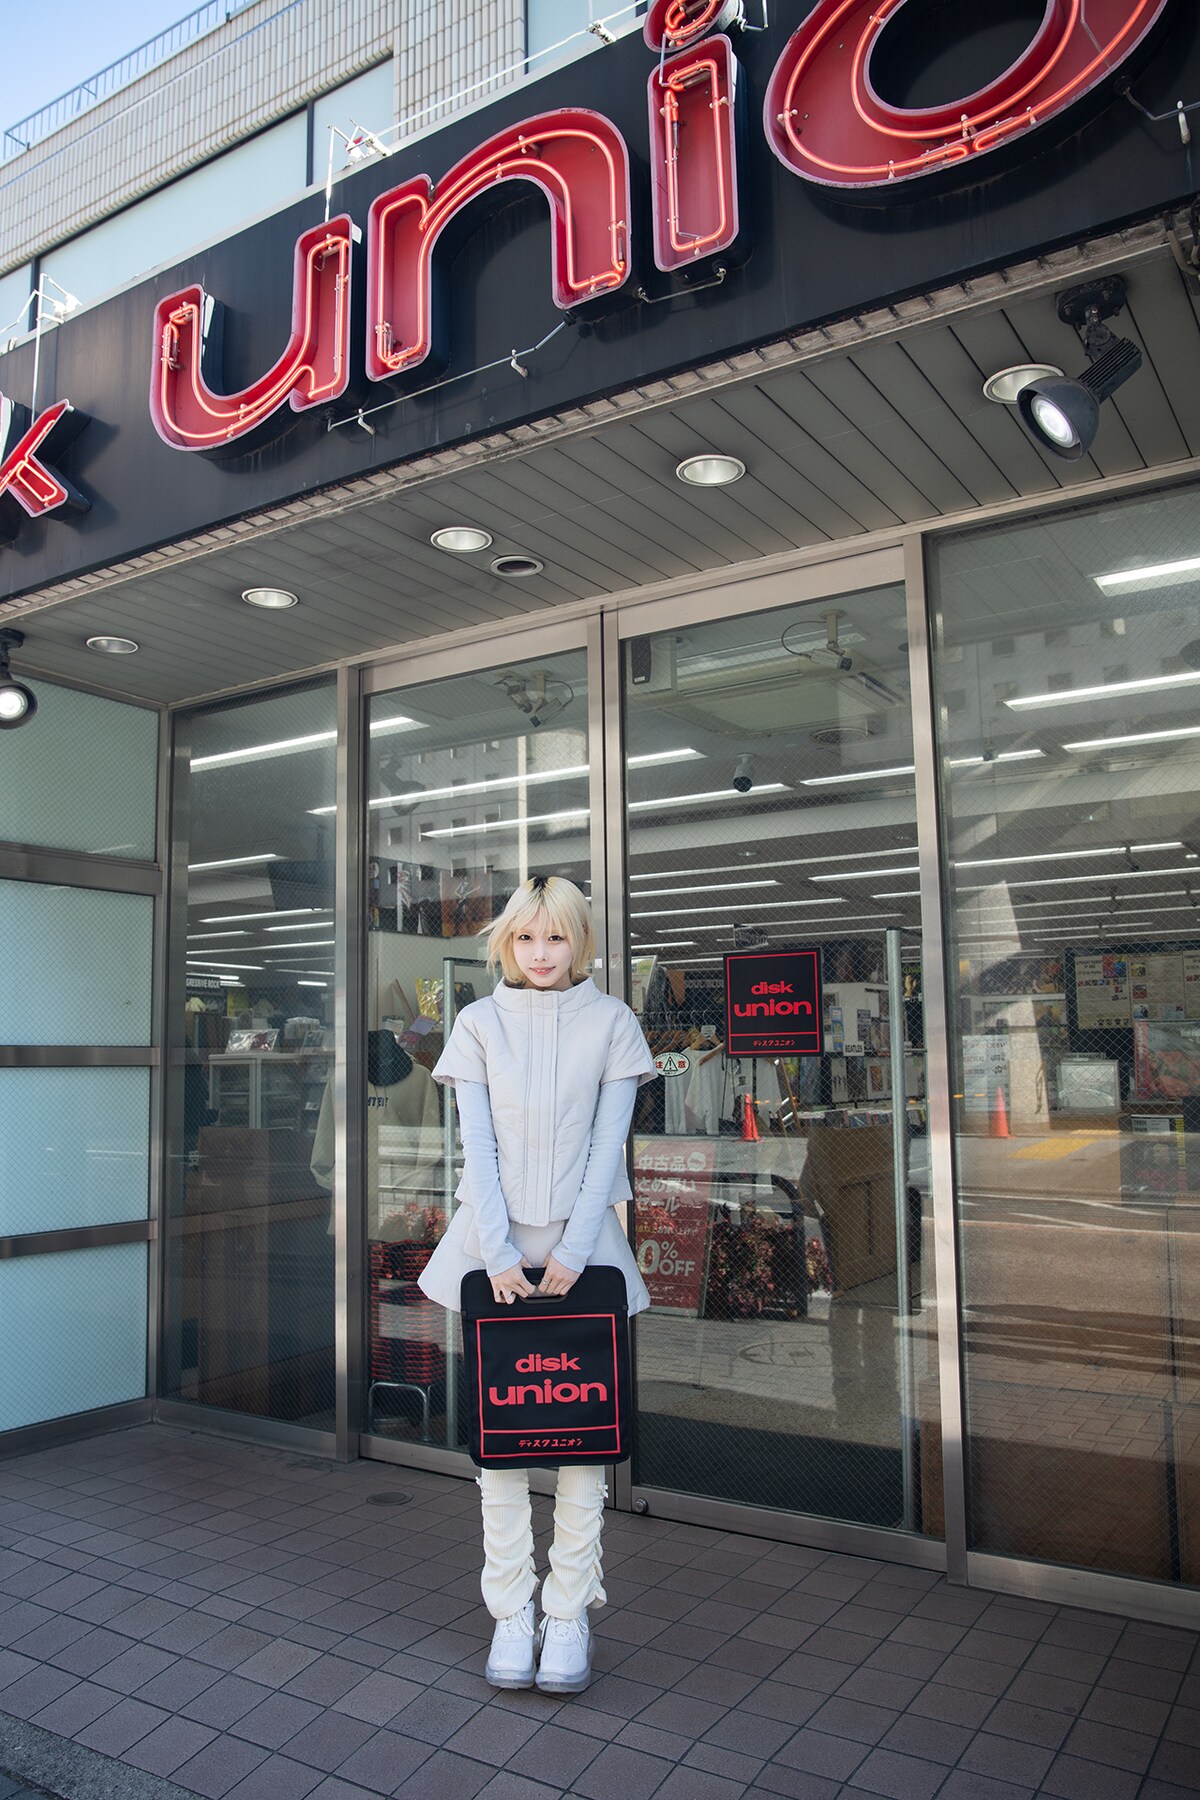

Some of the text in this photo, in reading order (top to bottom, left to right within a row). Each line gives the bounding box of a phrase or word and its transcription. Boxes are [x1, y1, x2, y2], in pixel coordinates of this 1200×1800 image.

[751, 981, 794, 995] disk
[733, 999, 812, 1017] union
[634, 1177, 697, 1193] とめ買い
[635, 1240, 696, 1277] 0% OFF
[515, 1353, 581, 1373] disk
[489, 1379, 608, 1406] union
[518, 1438, 583, 1448] ディスクユニオン
